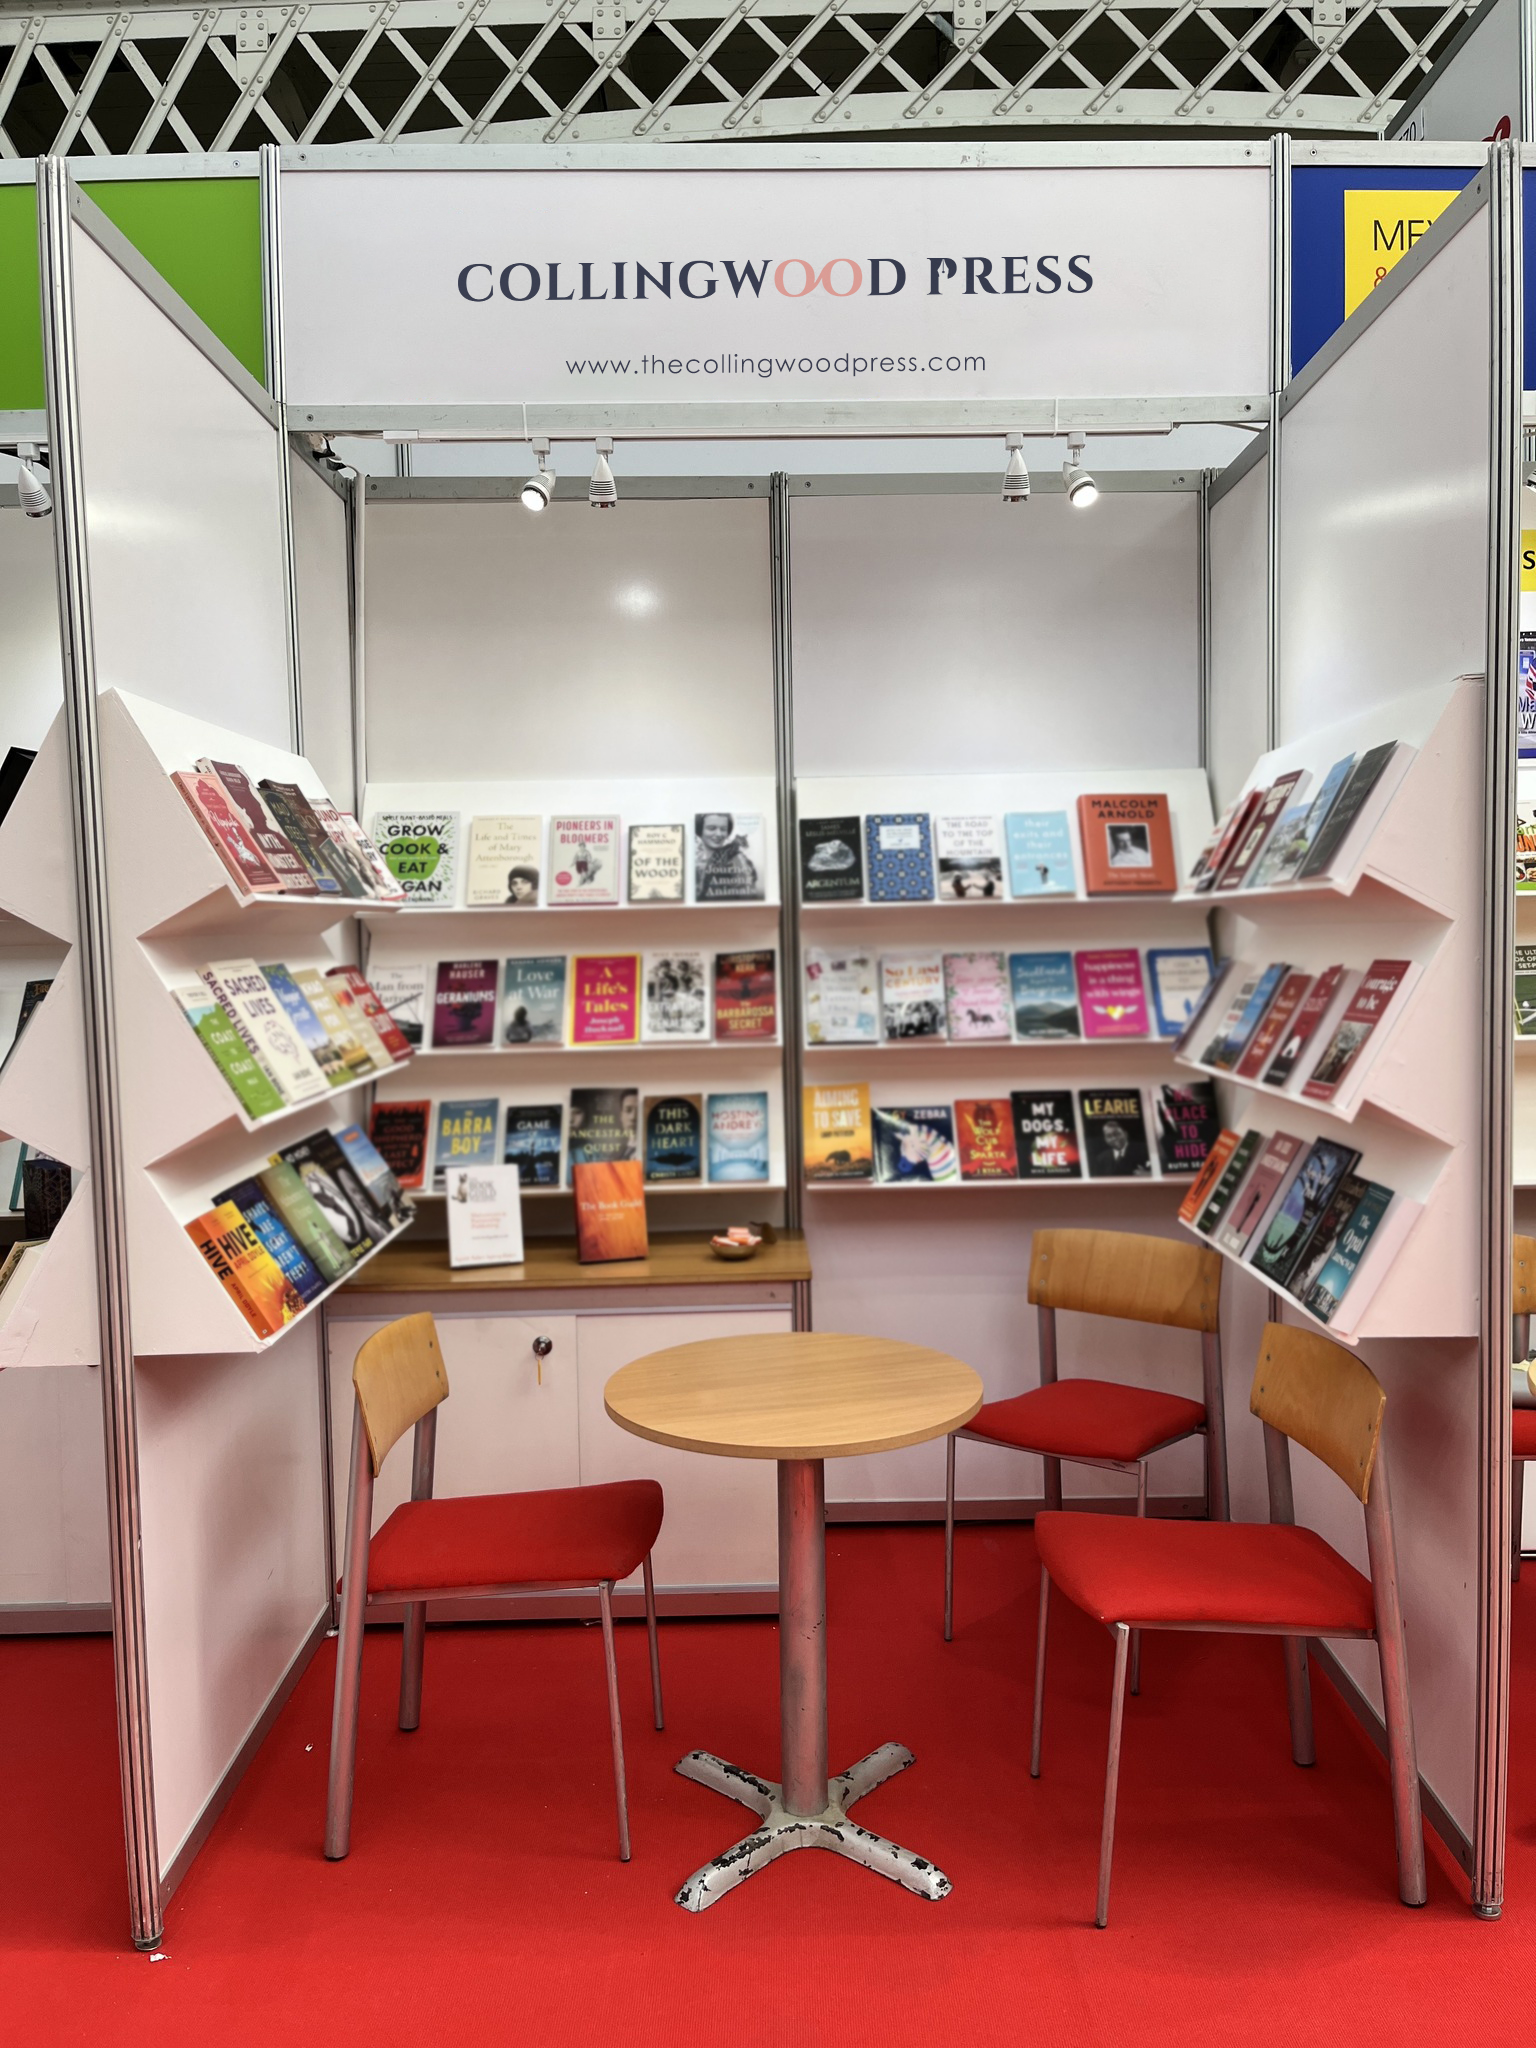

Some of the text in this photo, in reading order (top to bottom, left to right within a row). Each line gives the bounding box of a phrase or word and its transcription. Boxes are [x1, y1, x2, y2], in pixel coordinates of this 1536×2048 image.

[457, 254, 1094, 302] COLLINGWOOD PRESS
[565, 353, 986, 379] www.thecollingwoodpress.com
[1092, 799, 1158, 809] MALCOLM
[1098, 810, 1155, 819] ARNOLD
[388, 825, 445, 836] GROW
[497, 822, 513, 830] The
[556, 820, 614, 831] PIONEERS IN
[493, 833, 508, 841] and
[511, 833, 536, 841] Times
[560, 833, 609, 844] BLOOMERS
[379, 843, 431, 855] COOK
[437, 843, 449, 854] &
[499, 844, 522, 853] Mary
[398, 862, 427, 873] EAT
[634, 857, 679, 867] OF THE
[635, 869, 678, 878] WOOD
[401, 881, 442, 892] GAN
[600, 967, 613, 978] A
[1084, 961, 1135, 973] happiness
[450, 969, 485, 979] HAUSER
[517, 969, 554, 983] Love
[1108, 974, 1135, 986] thing
[223, 974, 267, 996] SACRED
[584, 982, 628, 996] Life's
[436, 991, 495, 1005] GERANIUMS
[508, 986, 559, 1001] at War
[203, 971, 261, 1055] SACRED LIVES
[242, 997, 276, 1018] LIVES
[582, 1000, 629, 1014] Tales
[717, 1007, 774, 1019] BARBAROSSA
[729, 1018, 762, 1030] SECRET
[813, 1088, 860, 1108] AIMING
[1031, 1102, 1054, 1116] MY
[1084, 1099, 1139, 1115] LEARIE
[593, 1115, 614, 1124] THE
[658, 1108, 689, 1120] THIS
[813, 1111, 830, 1129] TO
[832, 1109, 862, 1128] SAVE
[913, 1110, 947, 1120] ZEBRA
[441, 1116, 492, 1136] BARRA
[517, 1120, 550, 1131] GAME
[655, 1122, 692, 1135] DARK
[1022, 1118, 1069, 1133] DOGS,
[570, 1129, 634, 1139] ANCESTRAL
[1180, 1125, 1198, 1139] TO
[452, 1136, 481, 1155] BOY
[584, 1142, 620, 1154] QUEST
[652, 1136, 695, 1149] HEART
[1035, 1136, 1058, 1149] MY
[970, 1149, 1006, 1159] SPARTA
[1174, 1143, 1208, 1159] HIDE
[1032, 1152, 1067, 1166] LIFE
[580, 1202, 595, 1210] The
[598, 1201, 618, 1210] Book
[217, 1223, 258, 1260] HIVE
[1343, 1228, 1368, 1254] Opal
[234, 1246, 266, 1270] APRIL DOYLE
[200, 1239, 257, 1318] HIVE APRIL DOYLE
